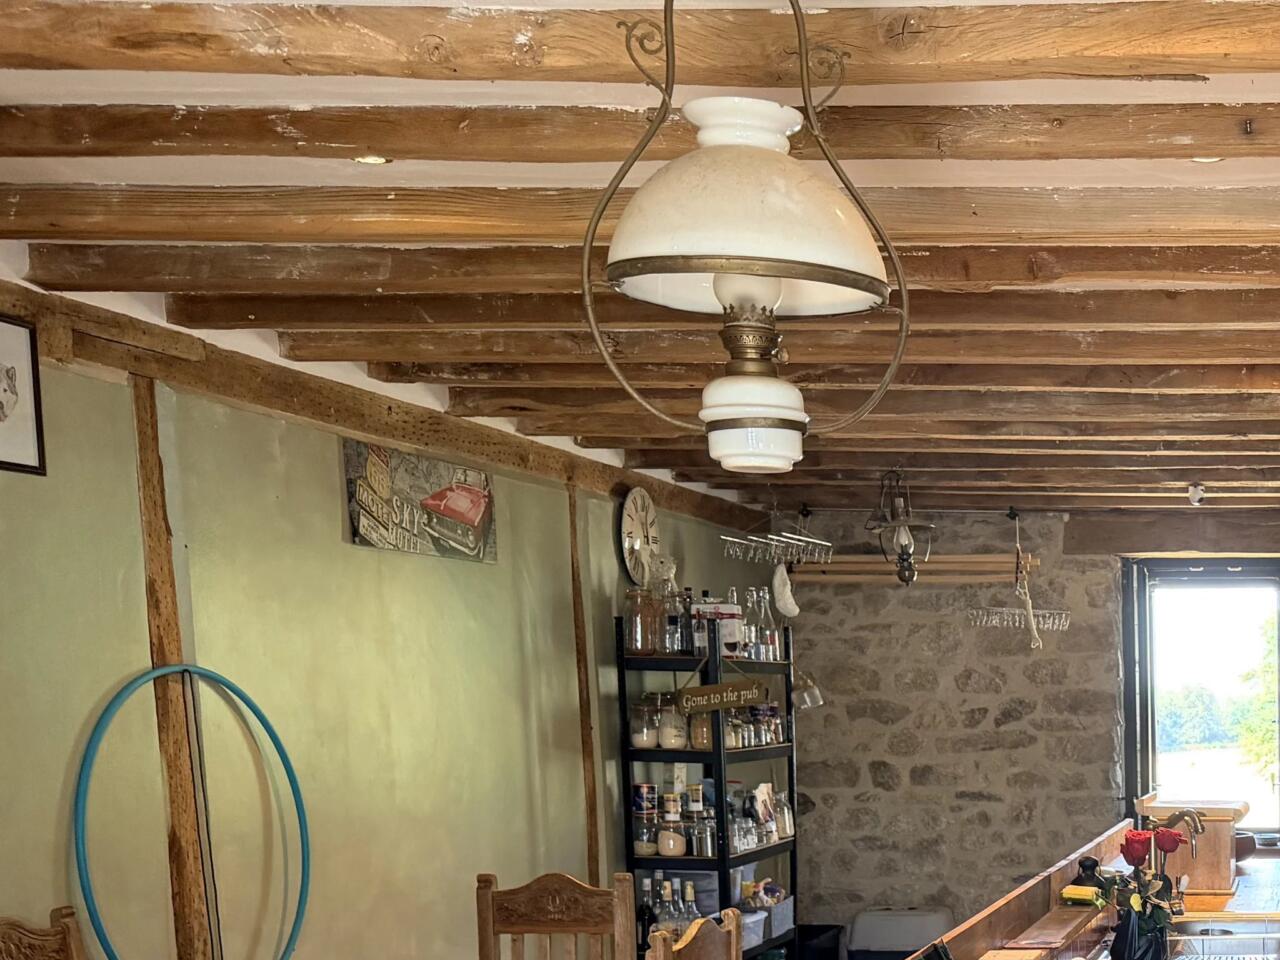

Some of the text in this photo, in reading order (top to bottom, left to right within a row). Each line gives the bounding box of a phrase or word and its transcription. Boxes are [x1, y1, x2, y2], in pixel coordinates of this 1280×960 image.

[393, 496, 420, 535] SKY
[683, 684, 759, 712] Gone to the pub
